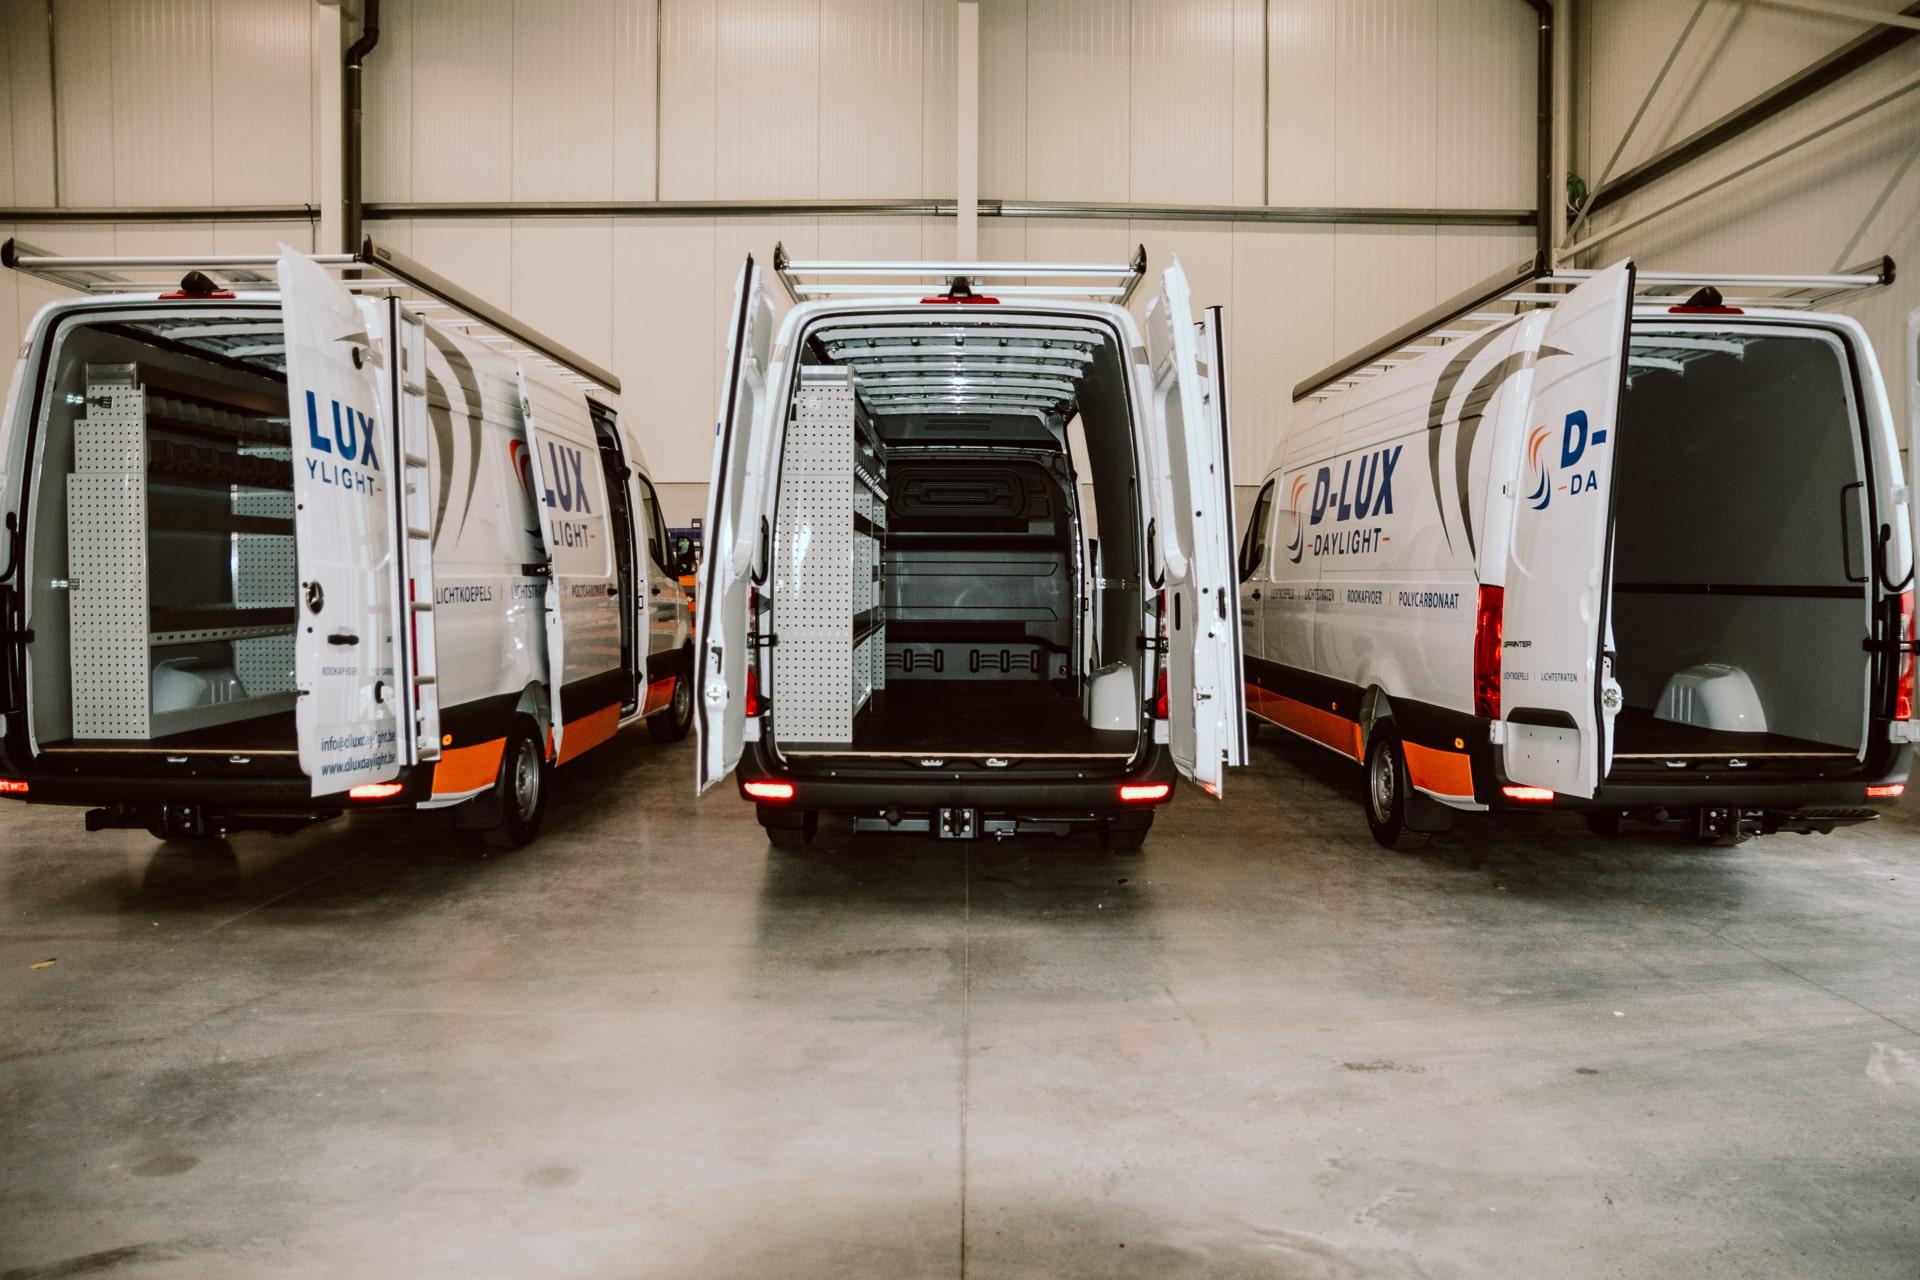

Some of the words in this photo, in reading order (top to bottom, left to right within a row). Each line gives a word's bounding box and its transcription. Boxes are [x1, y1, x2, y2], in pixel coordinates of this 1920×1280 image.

[306, 390, 380, 471] LUX
[1560, 409, 1607, 469] D-
[1310, 445, 1403, 525] D-LUX
[1314, 528, 1381, 555] DAYLIGHT
[435, 586, 492, 604] LICHTKOEPELS
[1347, 589, 1383, 605] ROOKAFVOER
[1400, 591, 1460, 609] POLYCARBONAAT
[1503, 640, 1532, 648] SPRINTER
[1540, 672, 1578, 682] LICHTSTRATEN
[321, 751, 396, 776] www.dluxdaylight.be
